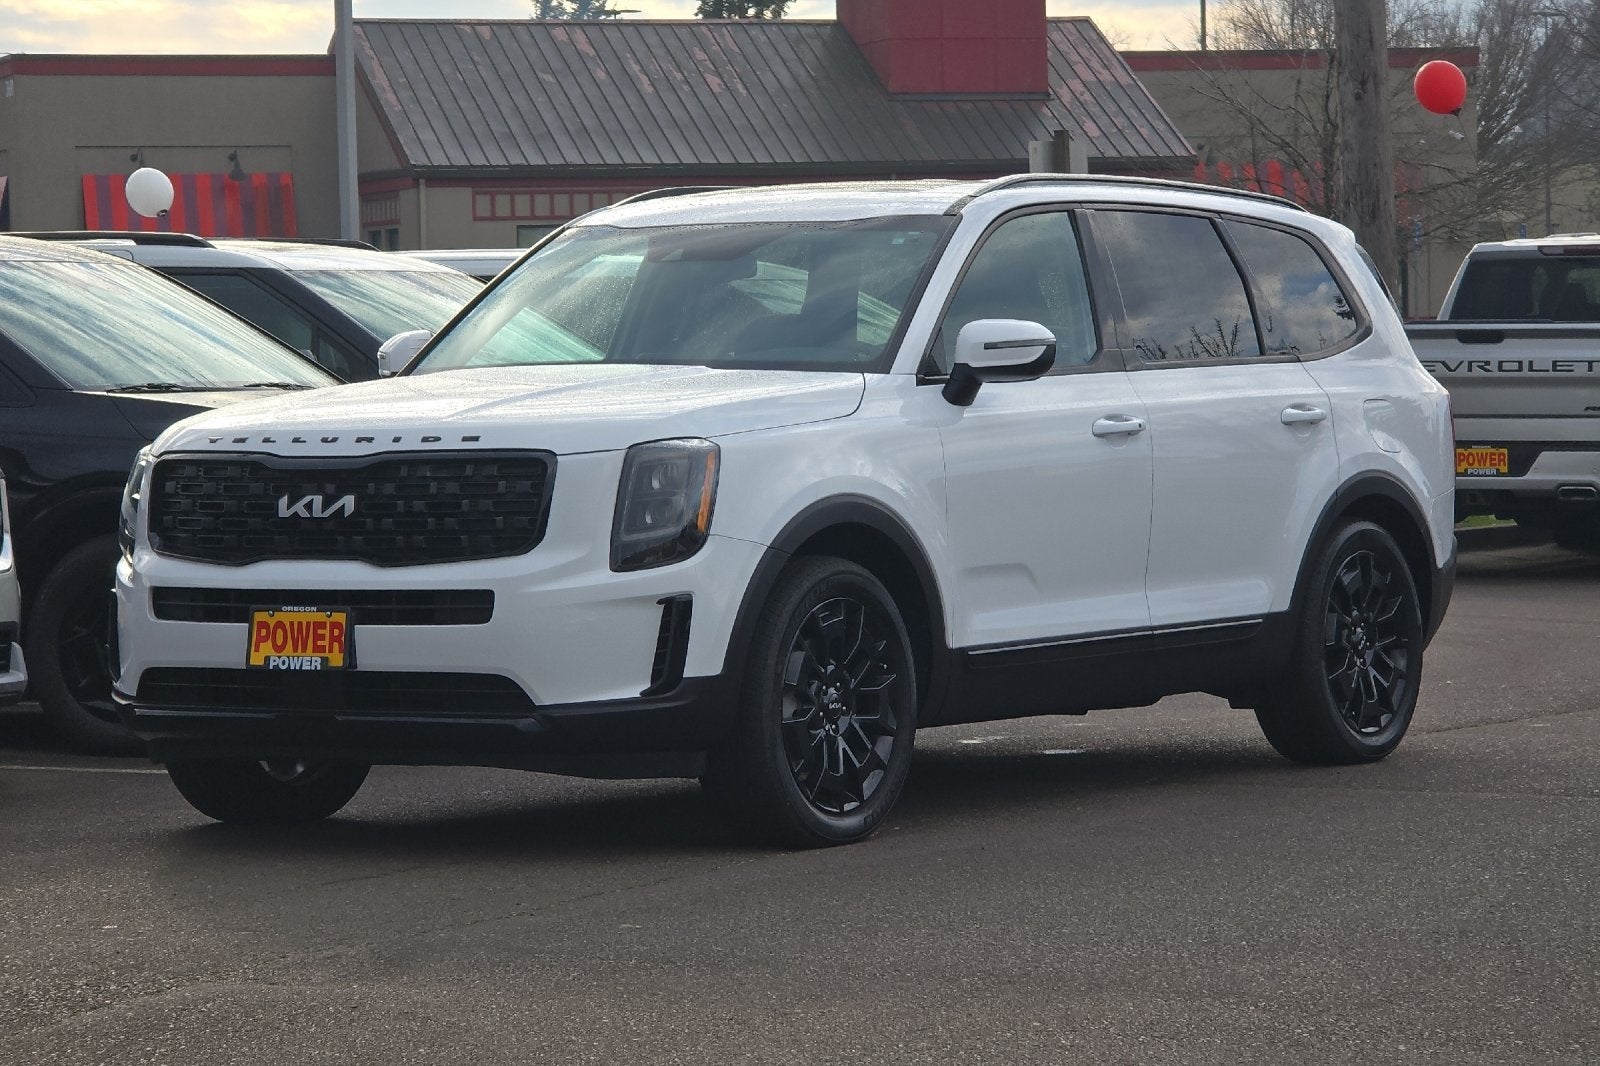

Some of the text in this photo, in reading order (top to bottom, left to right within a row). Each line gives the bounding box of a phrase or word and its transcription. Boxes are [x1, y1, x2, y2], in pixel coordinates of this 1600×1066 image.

[1419, 360, 1600, 373] EVROLET
[208, 435, 481, 444] TELLURIDE
[1457, 451, 1507, 467] POWER
[278, 494, 355, 518] KIA
[254, 620, 345, 654] POWER
[269, 656, 322, 670] POWER
